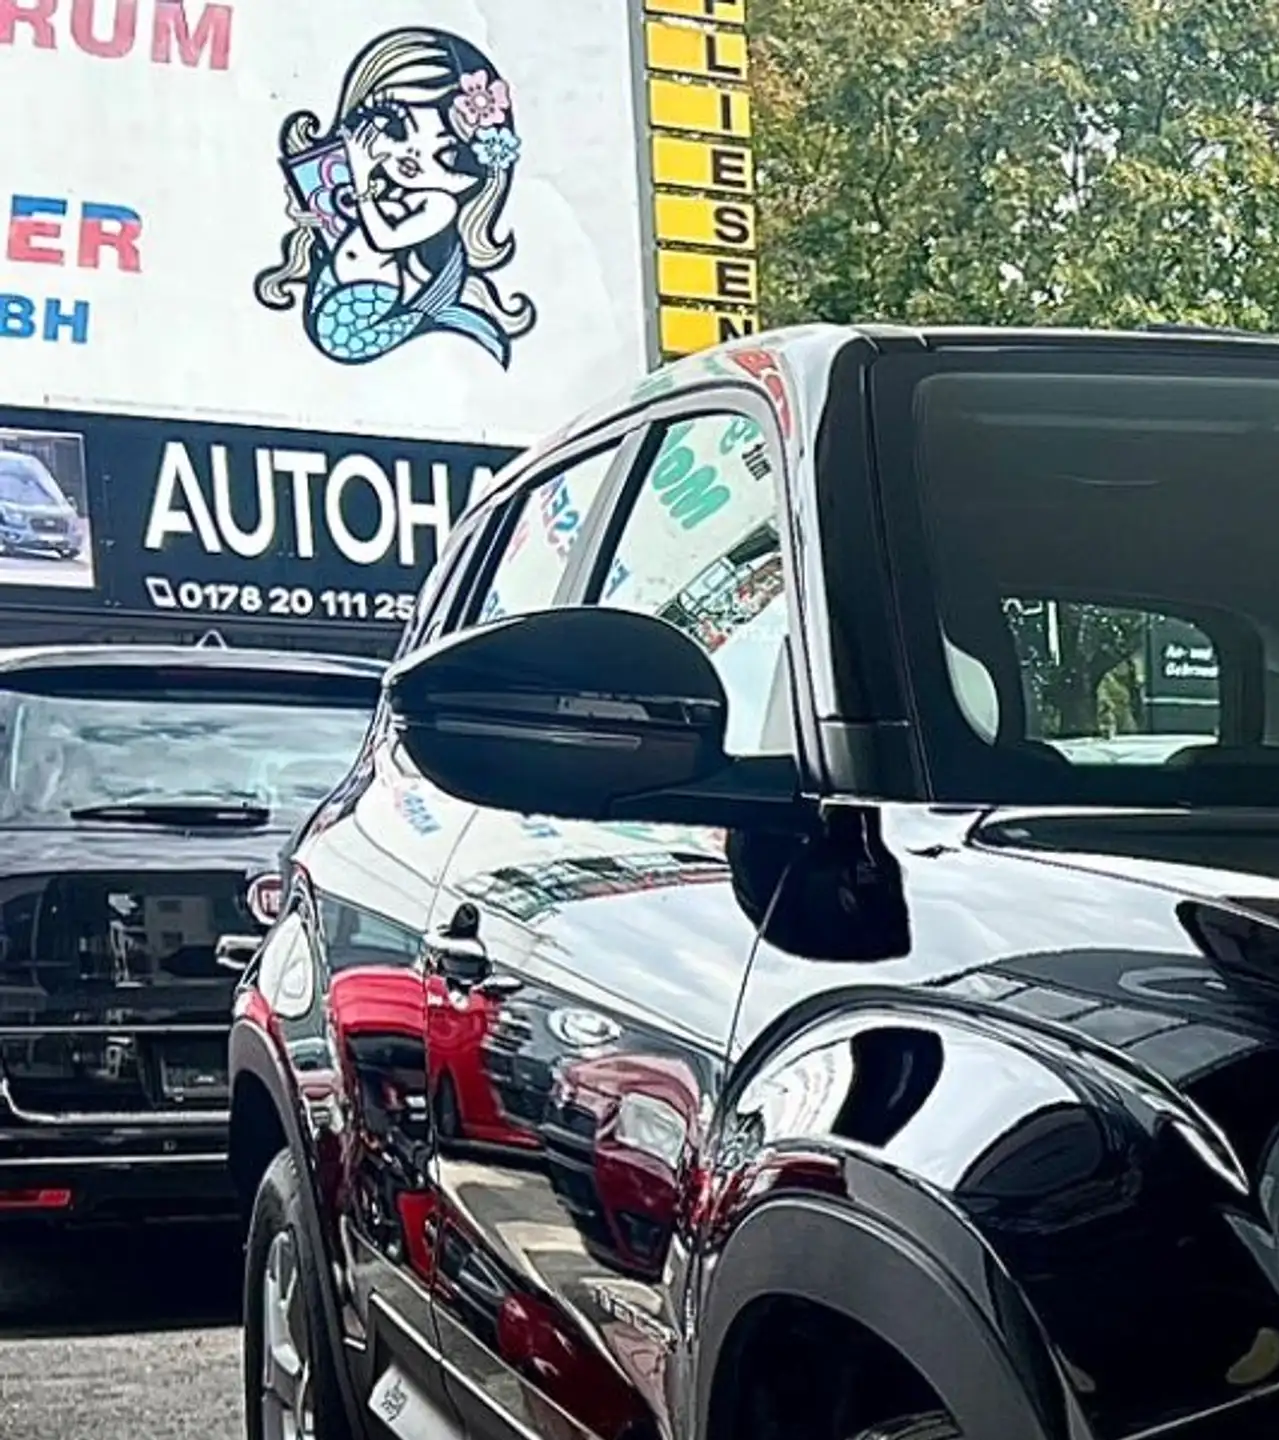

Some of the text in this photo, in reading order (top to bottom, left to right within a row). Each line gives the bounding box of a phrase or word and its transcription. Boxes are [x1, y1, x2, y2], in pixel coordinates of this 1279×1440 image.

[7, 194, 143, 273] ER
[179, 581, 263, 613] 0178
[268, 587, 314, 616] 20
[320, 590, 367, 618] 111
